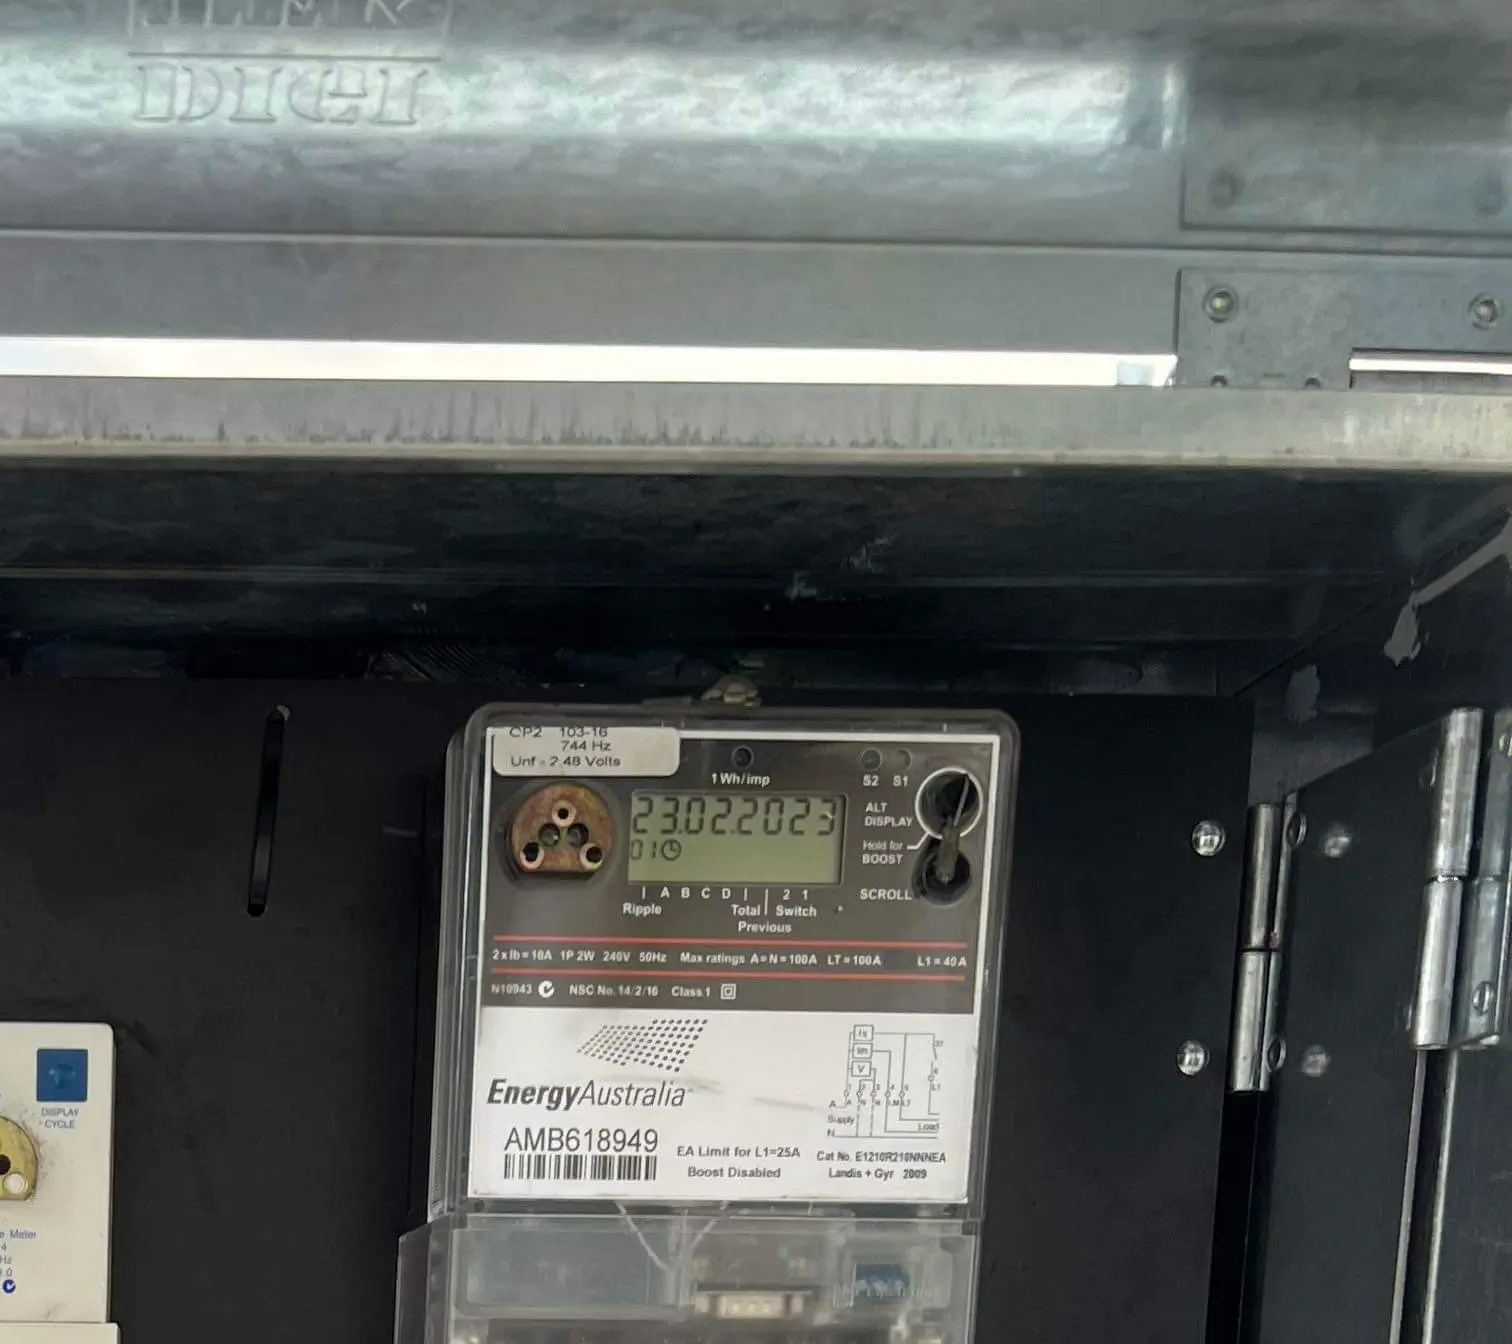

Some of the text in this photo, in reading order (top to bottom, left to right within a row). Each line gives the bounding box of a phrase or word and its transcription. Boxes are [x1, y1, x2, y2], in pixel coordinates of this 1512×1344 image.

[560, 740, 613, 752] 744 Hz
[584, 756, 622, 768] Volts
[862, 774, 880, 788] S2
[892, 774, 910, 788] S1
[864, 802, 888, 812] ALT
[632, 796, 836, 836] 23.02.2023
[864, 816, 914, 828] DISPLAY
[890, 840, 904, 850] for
[862, 854, 904, 864] BOOST
[660, 888, 808, 900] A B C D 2 1
[859, 888, 913, 900] SCROLL
[622, 902, 817, 918] Ripple Total Switch
[738, 920, 792, 934] Previous
[602, 950, 632, 962] 240V
[638, 950, 668, 963] 50Hz
[680, 952, 704, 963] Max
[706, 952, 746, 968] ratings
[568, 984, 594, 996] NSC
[670, 986, 702, 998] Class
[487, 1078, 686, 1112] EnergyAustralia
[40, 1106, 80, 1117] DISPLAY
[44, 1120, 75, 1128] CYCLE
[504, 1126, 658, 1152] AMB618949
[676, 1146, 695, 1158] EA
[698, 1146, 730, 1158] Limit
[734, 1146, 752, 1158] for
[816, 1150, 836, 1162] Cat
[688, 1166, 782, 1178] Boost Disabled
[828, 1166, 928, 1180] Landis Gyr 2009
[10, 1230, 36, 1239] Meter
